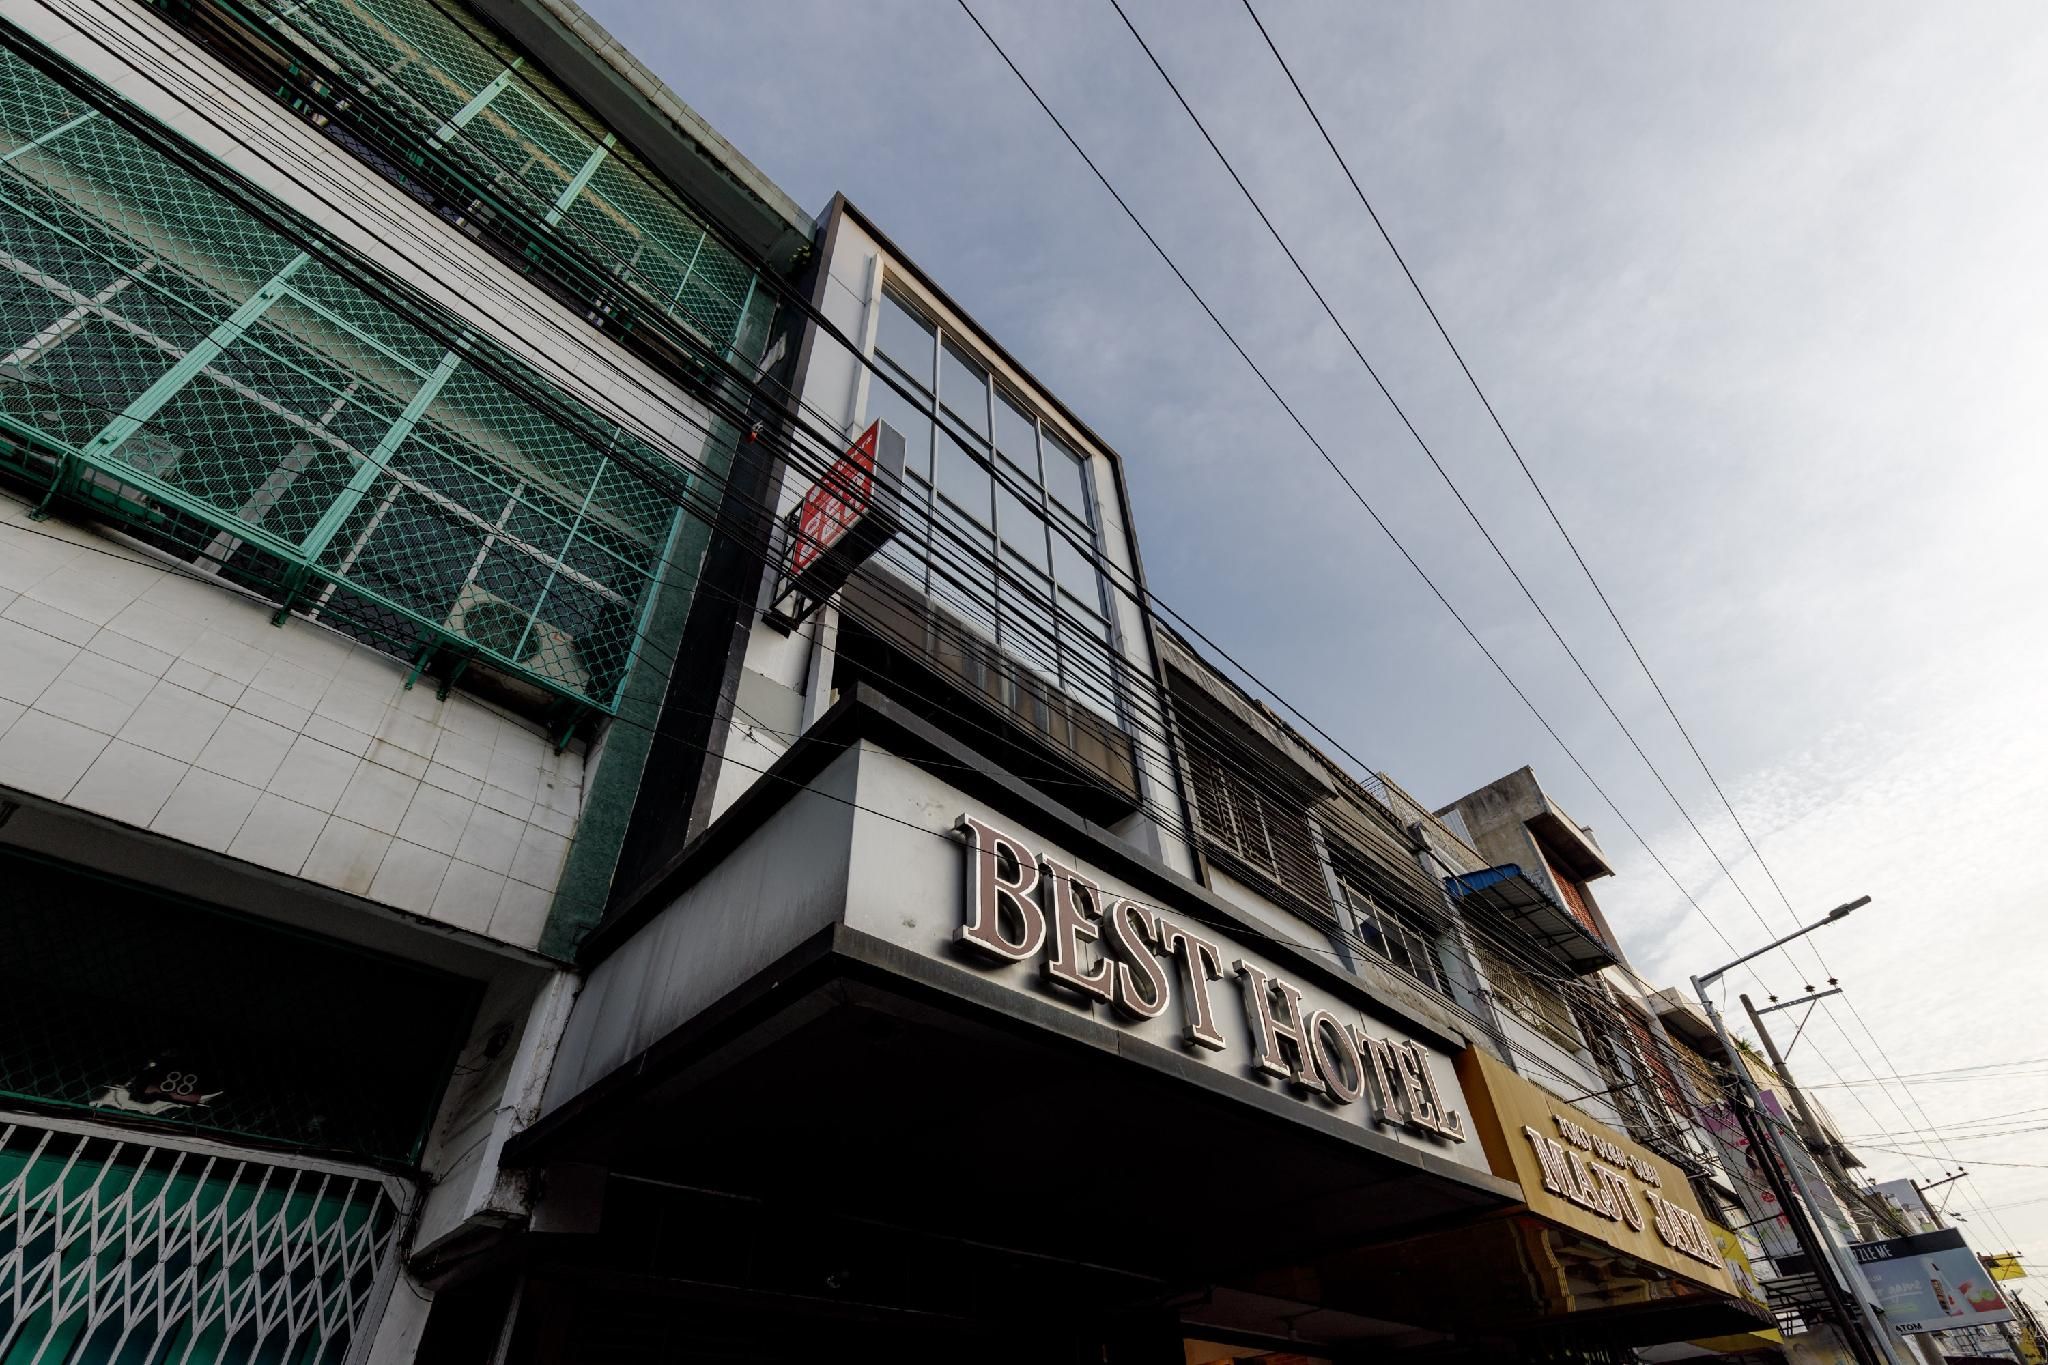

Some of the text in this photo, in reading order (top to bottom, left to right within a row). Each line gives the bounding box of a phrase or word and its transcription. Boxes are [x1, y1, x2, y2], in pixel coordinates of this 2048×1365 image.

[954, 813, 1467, 1143] BEST HOTEL
[160, 1071, 197, 1095] 88
[1522, 1125, 1723, 1270] MAJU JAYA
[1895, 1322, 1922, 1332] ATOM
